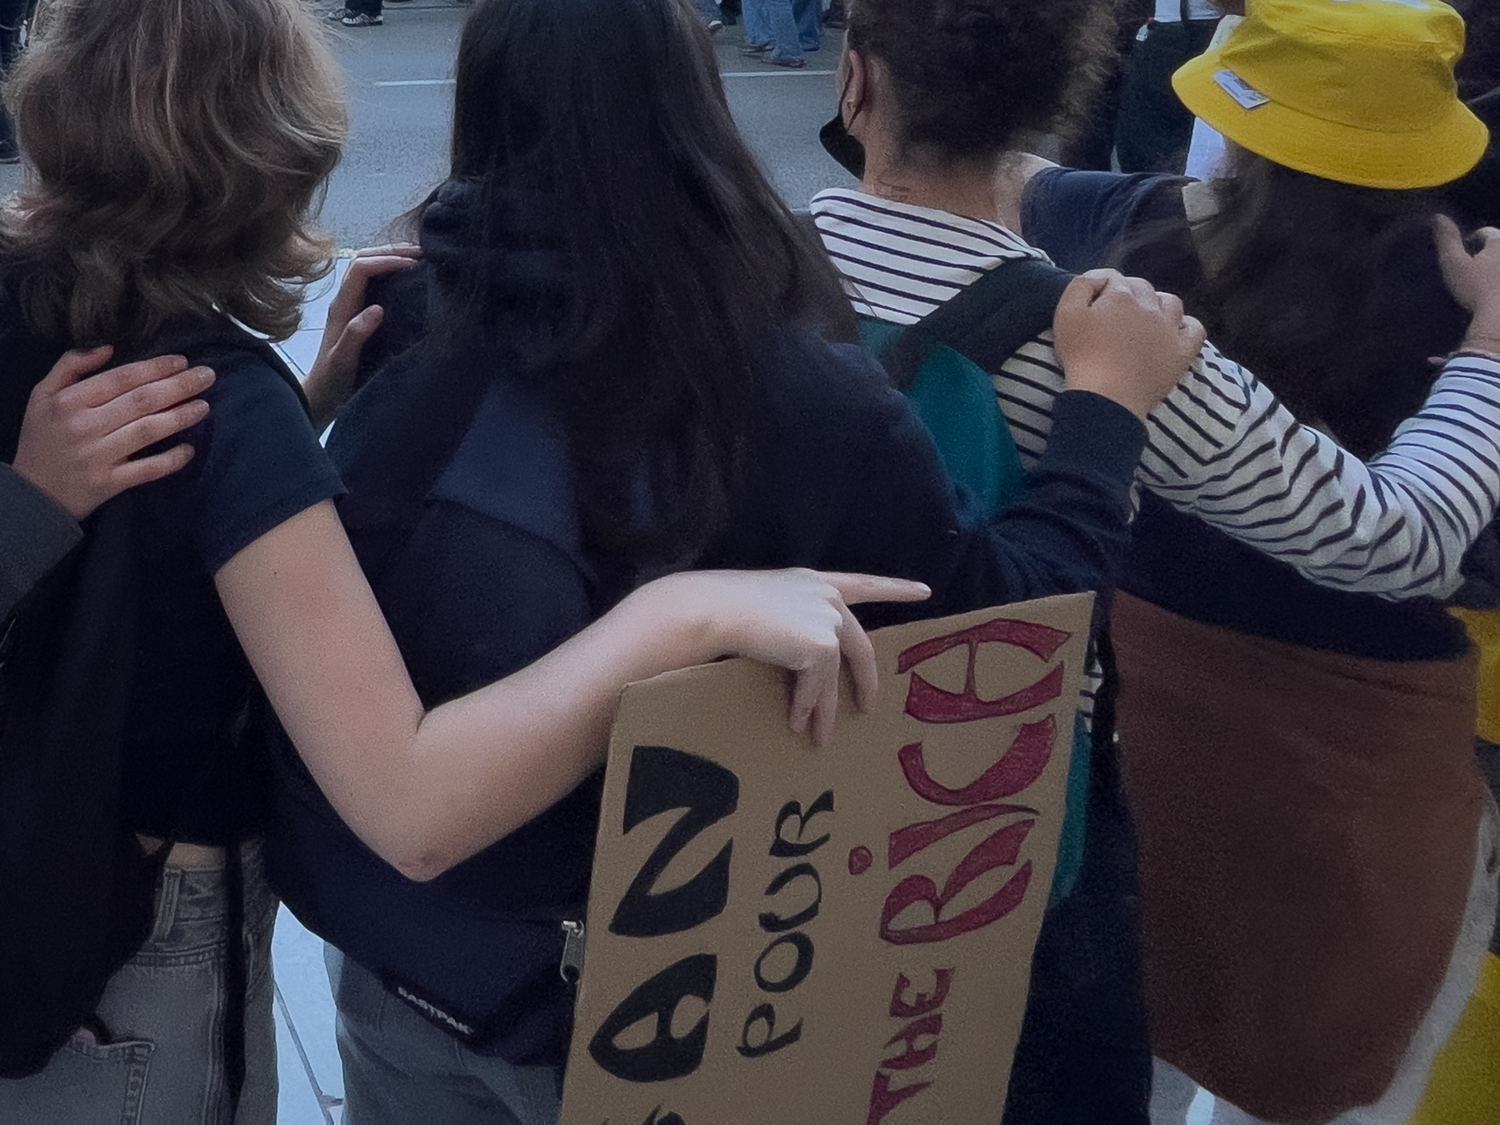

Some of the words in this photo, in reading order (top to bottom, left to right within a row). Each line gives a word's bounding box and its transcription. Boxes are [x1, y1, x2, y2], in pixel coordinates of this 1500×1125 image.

[398, 986, 474, 1035] EASTPAK
[587, 744, 740, 1125] AN
[735, 789, 835, 1058] POUR
[866, 967, 956, 1125] THE
